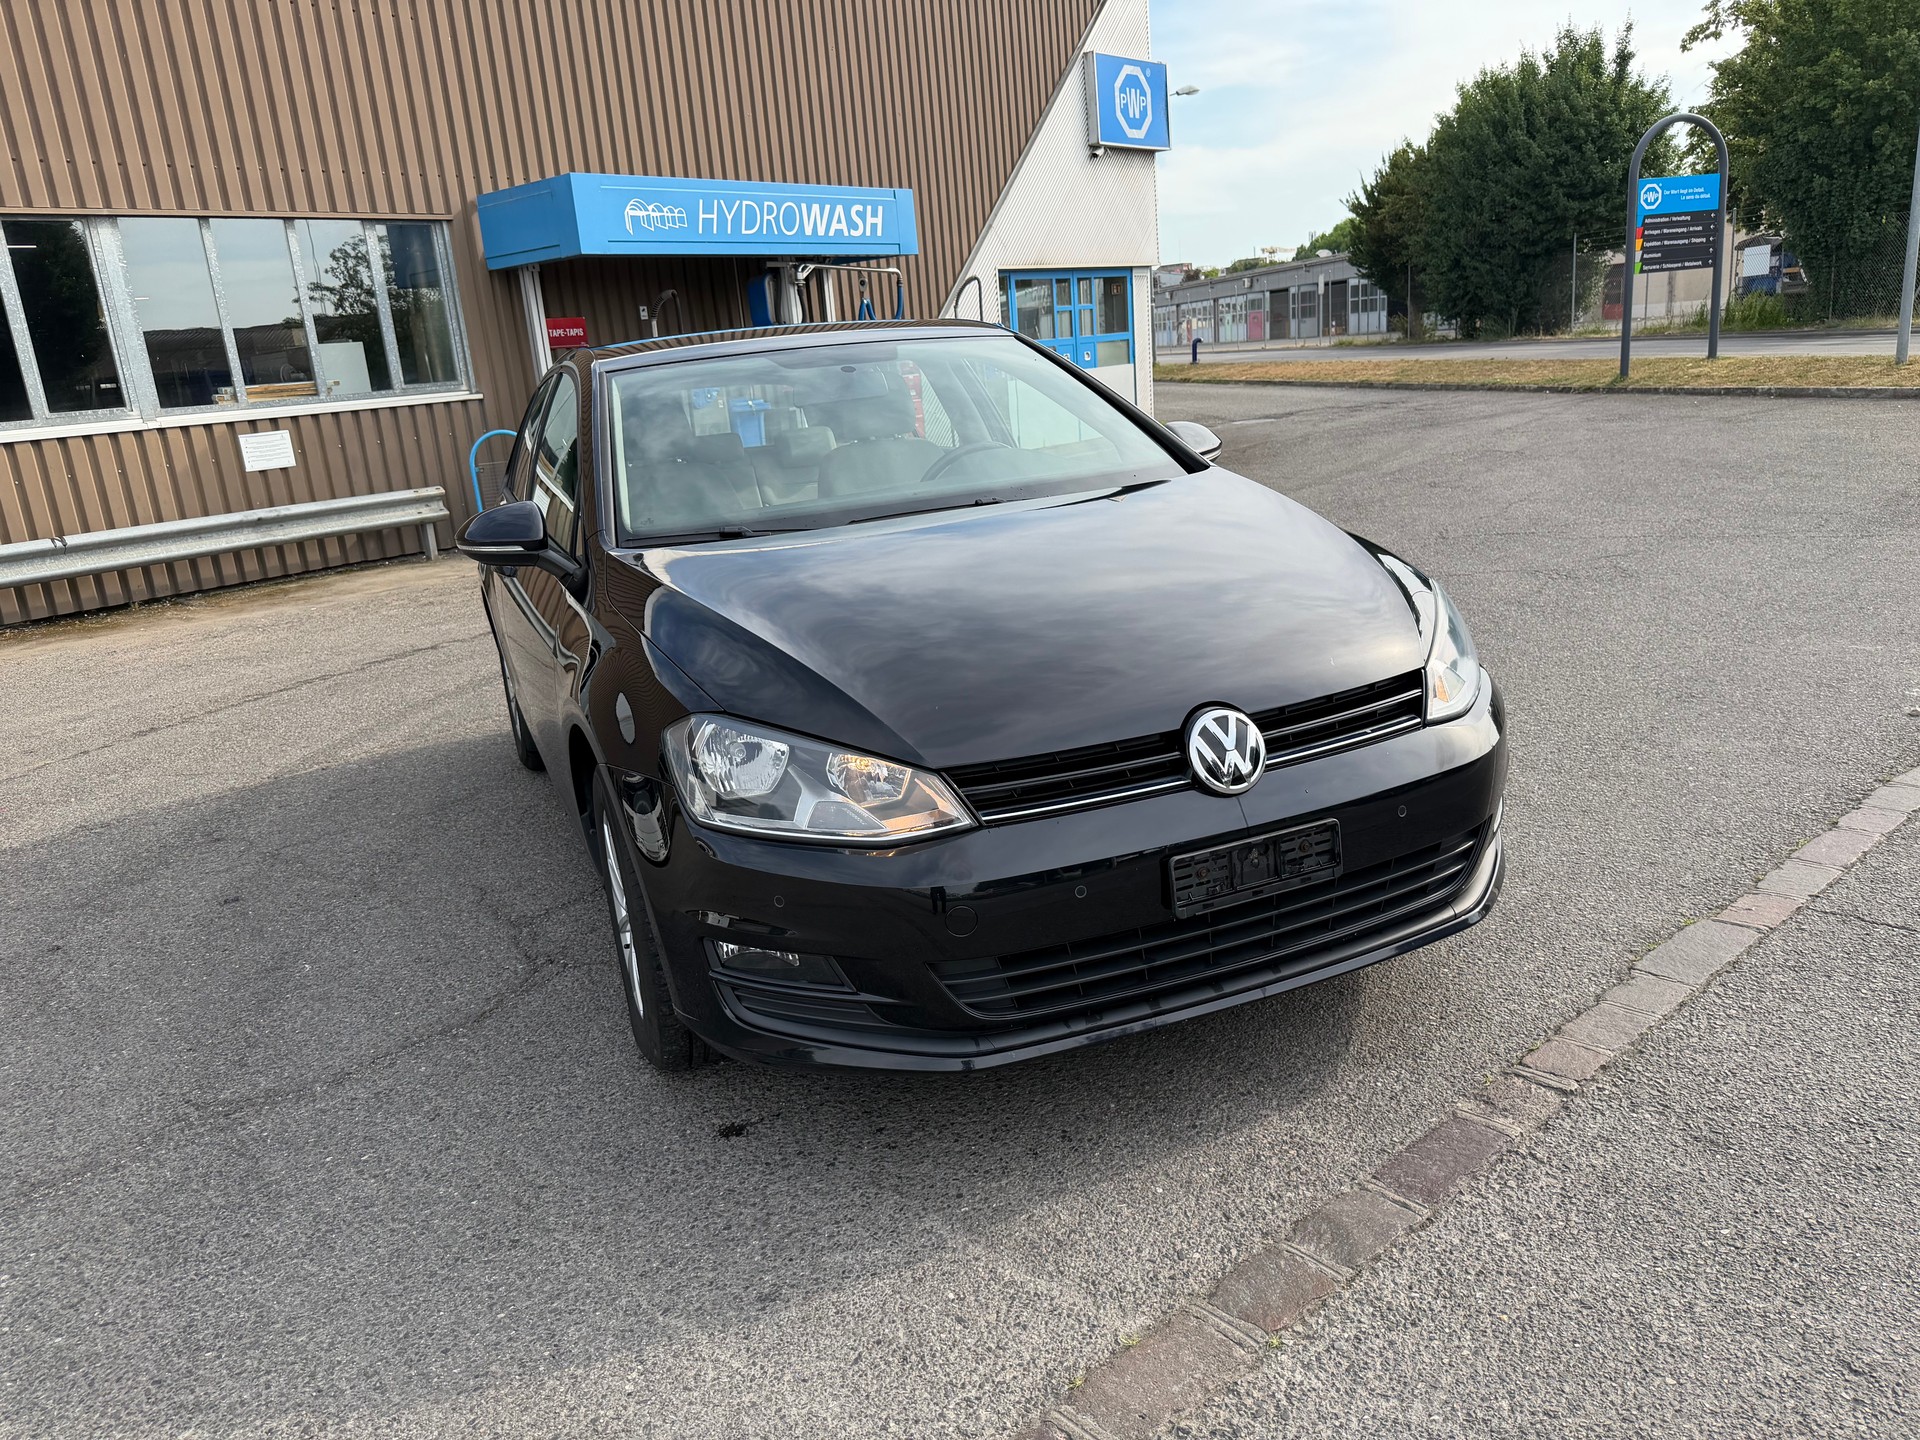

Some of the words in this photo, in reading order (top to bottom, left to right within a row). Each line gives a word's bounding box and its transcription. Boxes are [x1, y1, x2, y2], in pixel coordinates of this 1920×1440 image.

[1120, 87, 1147, 119] PWP
[1643, 191, 1659, 203] PWP
[698, 199, 883, 237] HYDROWASH
[549, 328, 584, 337] TAPE-TAPIS
